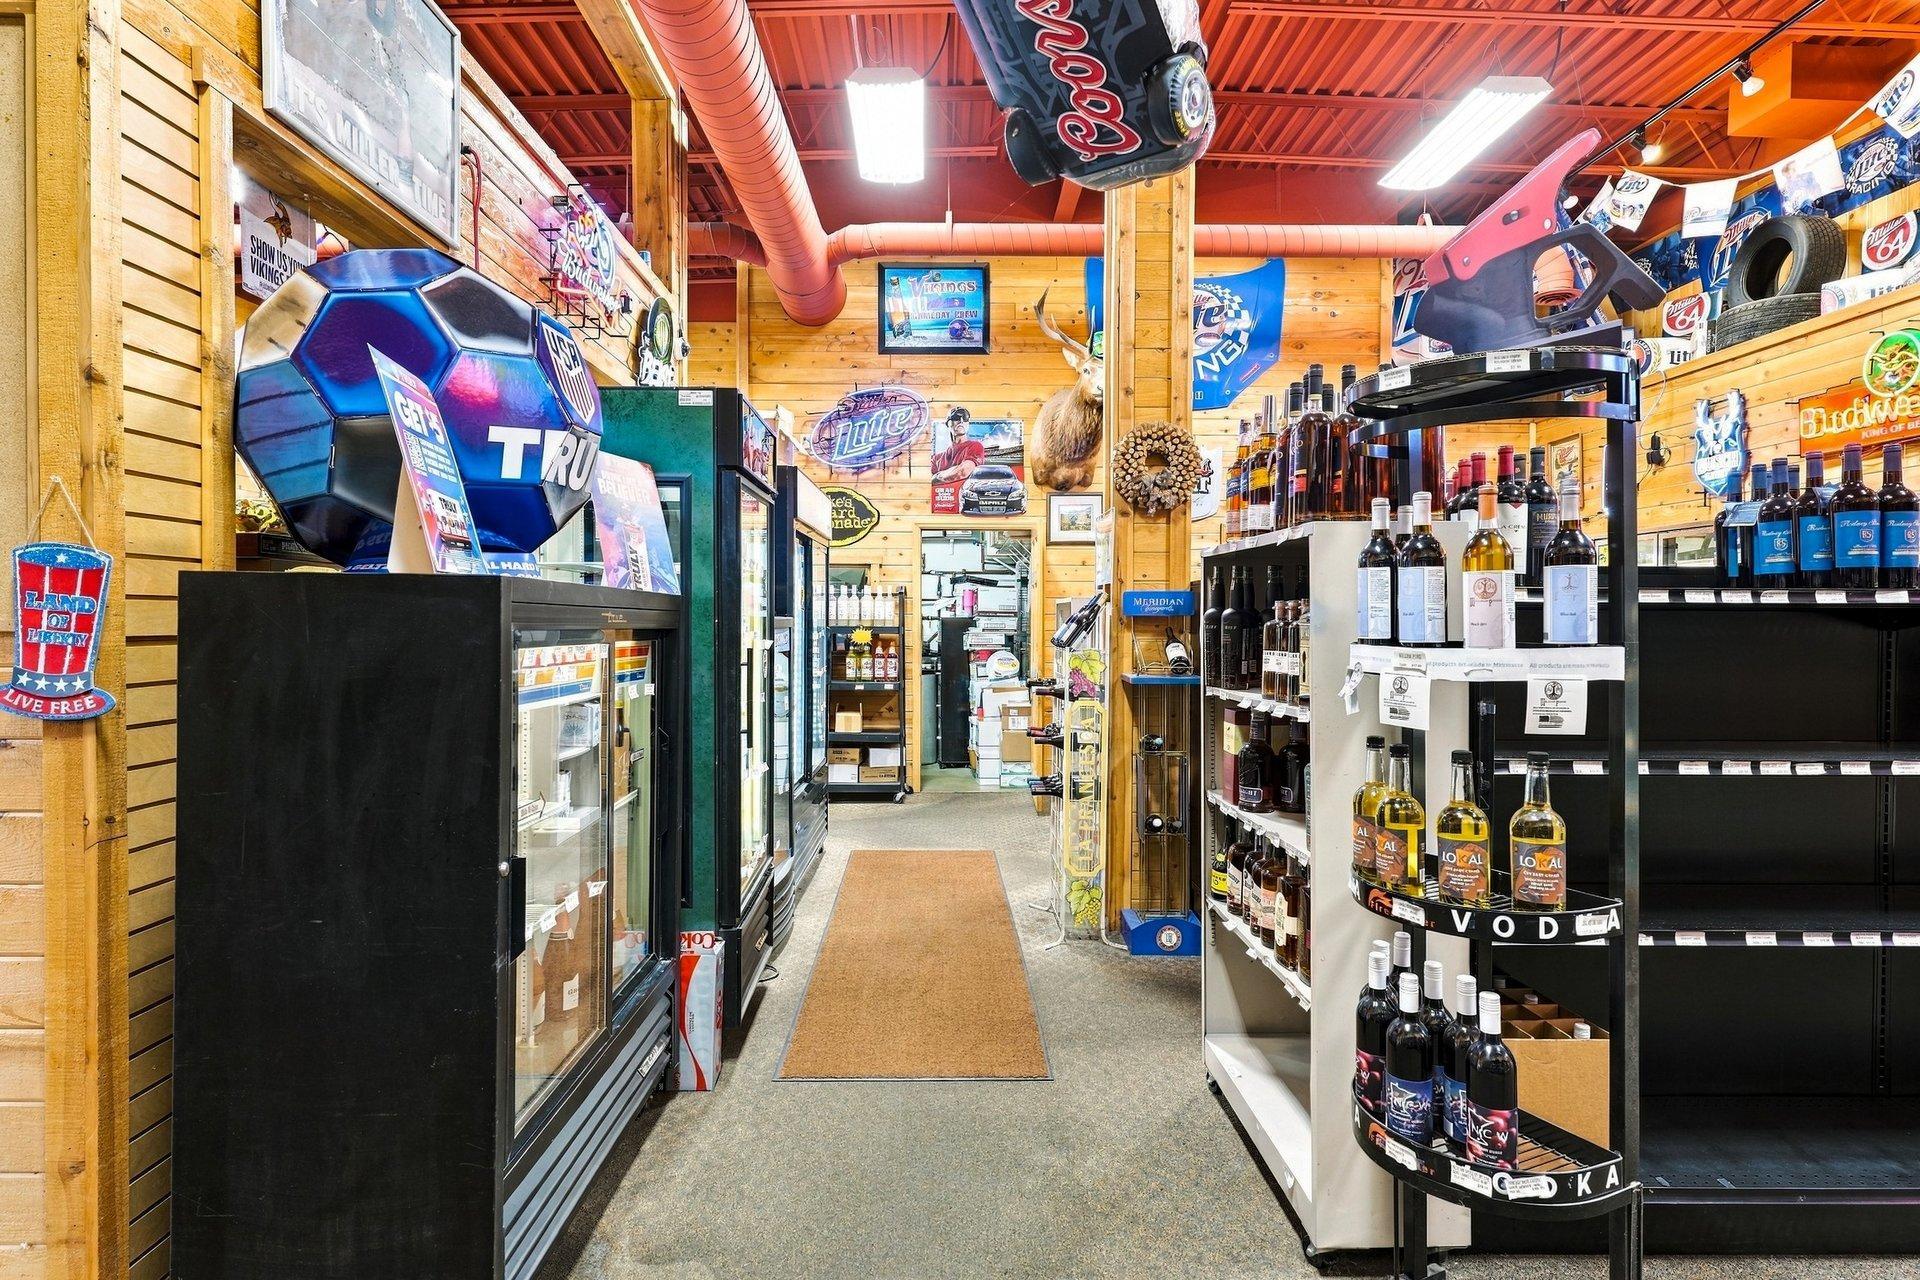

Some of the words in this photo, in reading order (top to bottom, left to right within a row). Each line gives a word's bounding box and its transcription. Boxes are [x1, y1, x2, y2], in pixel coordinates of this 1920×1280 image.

[334, 110, 402, 188] MILLER
[411, 173, 449, 227] TIME
[1846, 160, 1896, 194] RACING
[1724, 213, 1758, 242] Miller
[1867, 216, 1907, 246] Miller
[250, 234, 275, 265] SHOW
[276, 249, 288, 273] US
[1876, 227, 1906, 261] 64
[250, 255, 285, 286] VIKINGS
[907, 270, 978, 299] Vikings
[1667, 293, 1701, 316] Miller
[1674, 303, 1703, 330] 64
[545, 328, 582, 372] USA
[393, 390, 430, 438] GET
[831, 405, 913, 462] Lite
[1862, 427, 1888, 439] KING
[1890, 423, 1906, 433] OF
[25, 591, 97, 614] LAND
[1133, 597, 1184, 606] MERIDIAN
[47, 614, 69, 630] OF
[27, 628, 88, 646] LIBERTY
[3, 688, 44, 714] LIVE
[50, 695, 97, 715] FREE
[1078, 715, 1094, 831] FRANCESA
[1519, 854, 1563, 870] LOKAL
